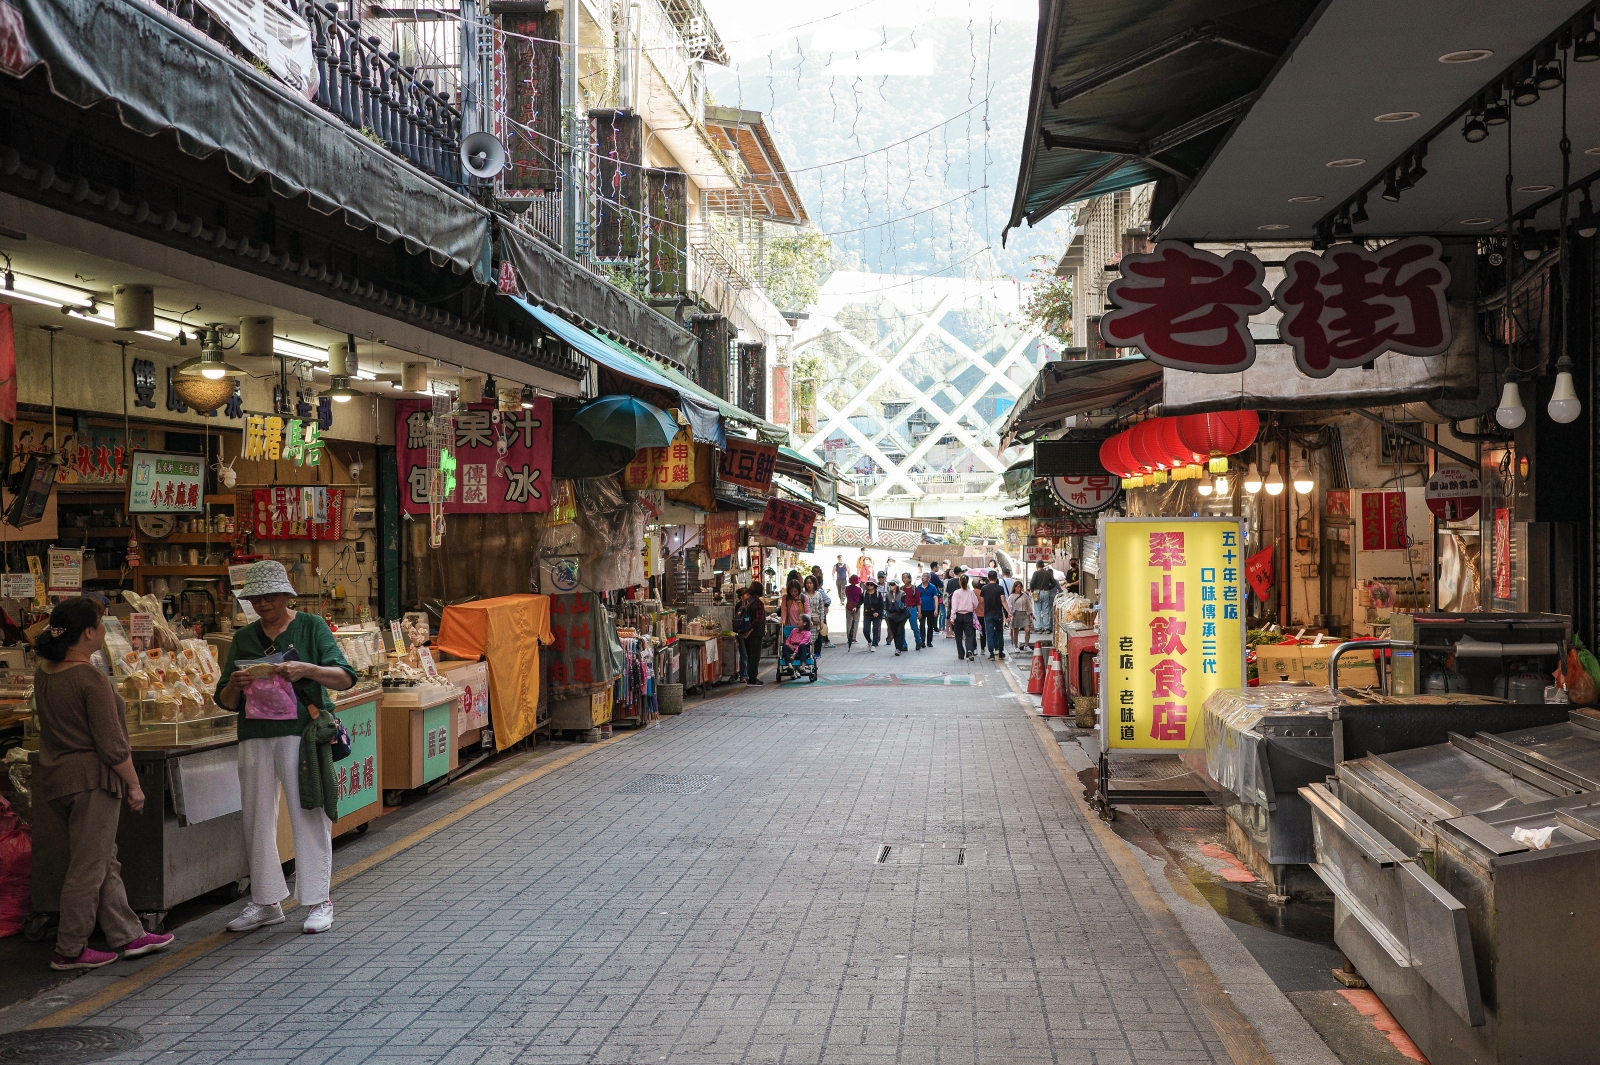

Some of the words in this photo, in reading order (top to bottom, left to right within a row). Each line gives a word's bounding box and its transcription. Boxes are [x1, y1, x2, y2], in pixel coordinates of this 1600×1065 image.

[1105, 244, 1447, 374] 老街
[406, 409, 542, 449] 鮮果汁
[719, 448, 775, 484] 紅豆餅
[150, 480, 199, 509] 小米麻糬
[1071, 492, 1087, 504] 味
[761, 522, 806, 546] 創始店
[1026, 547, 1052, 555] 山豬肉
[1222, 531, 1238, 620] 五十年老店
[1201, 567, 1217, 674] 口味傳承三代
